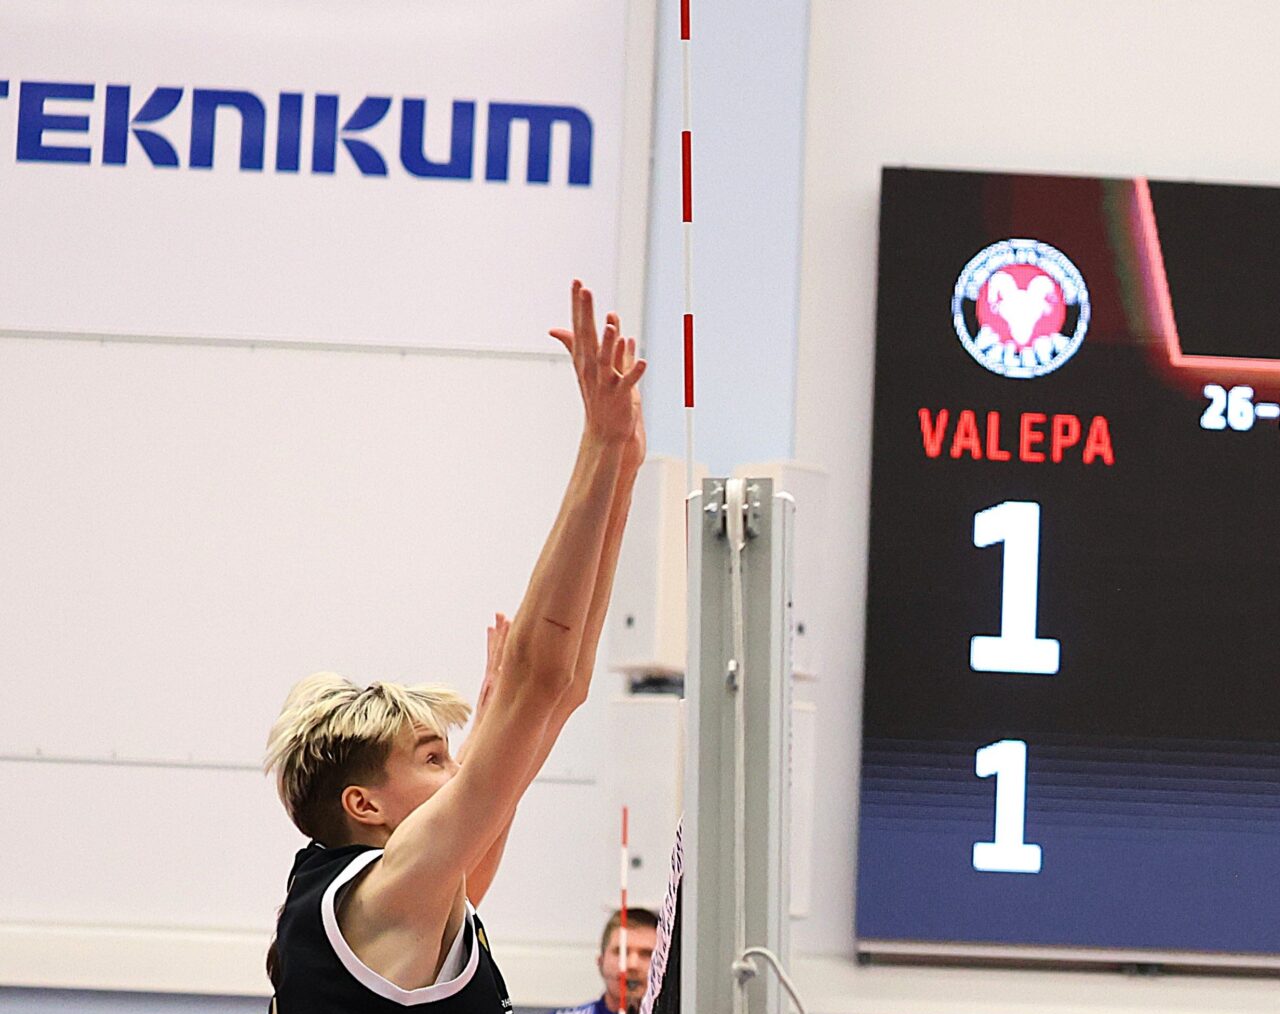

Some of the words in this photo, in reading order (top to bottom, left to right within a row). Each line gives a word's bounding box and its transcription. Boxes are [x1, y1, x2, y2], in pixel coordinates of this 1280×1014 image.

[918, 408, 1115, 466] VALEPA
[970, 501, 1060, 675] 1
[972, 738, 1042, 873] 1
